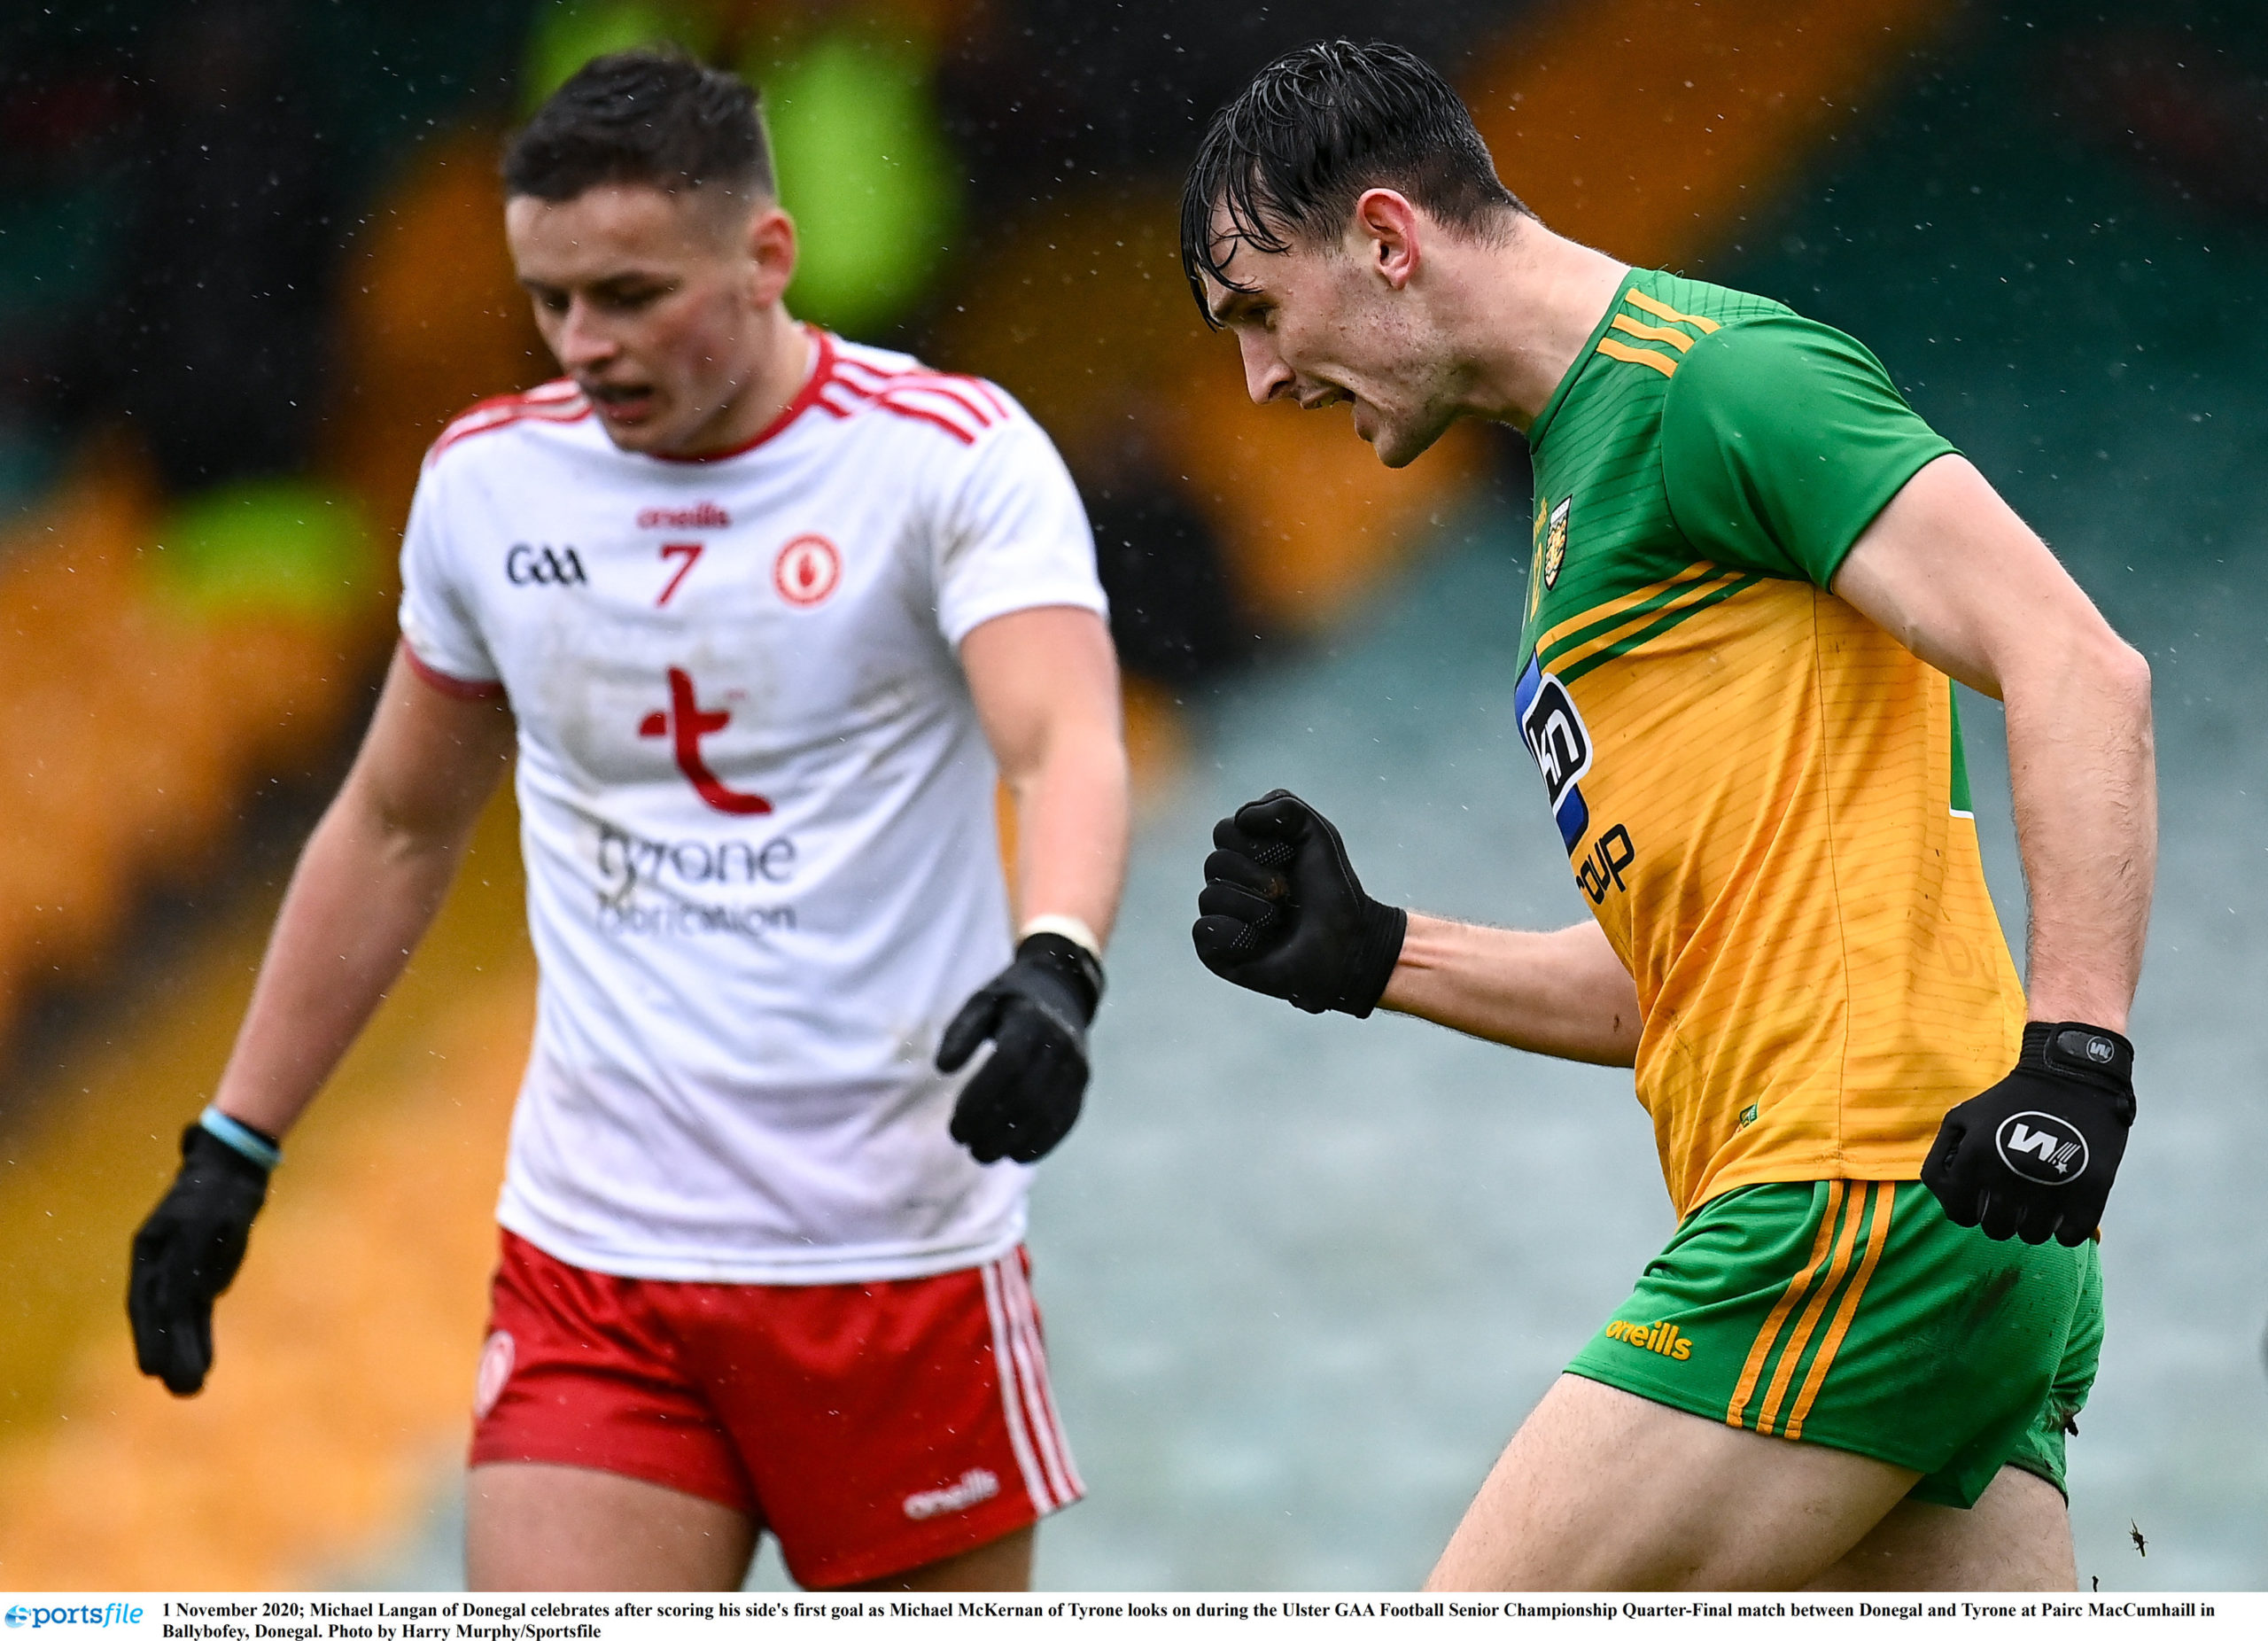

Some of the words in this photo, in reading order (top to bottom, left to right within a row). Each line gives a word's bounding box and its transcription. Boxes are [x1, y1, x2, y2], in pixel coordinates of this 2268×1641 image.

[506, 543, 586, 585] GAA
[656, 543, 705, 606] 7
[596, 826, 797, 898] tyrone
[1605, 1319, 1695, 1362] oneills
